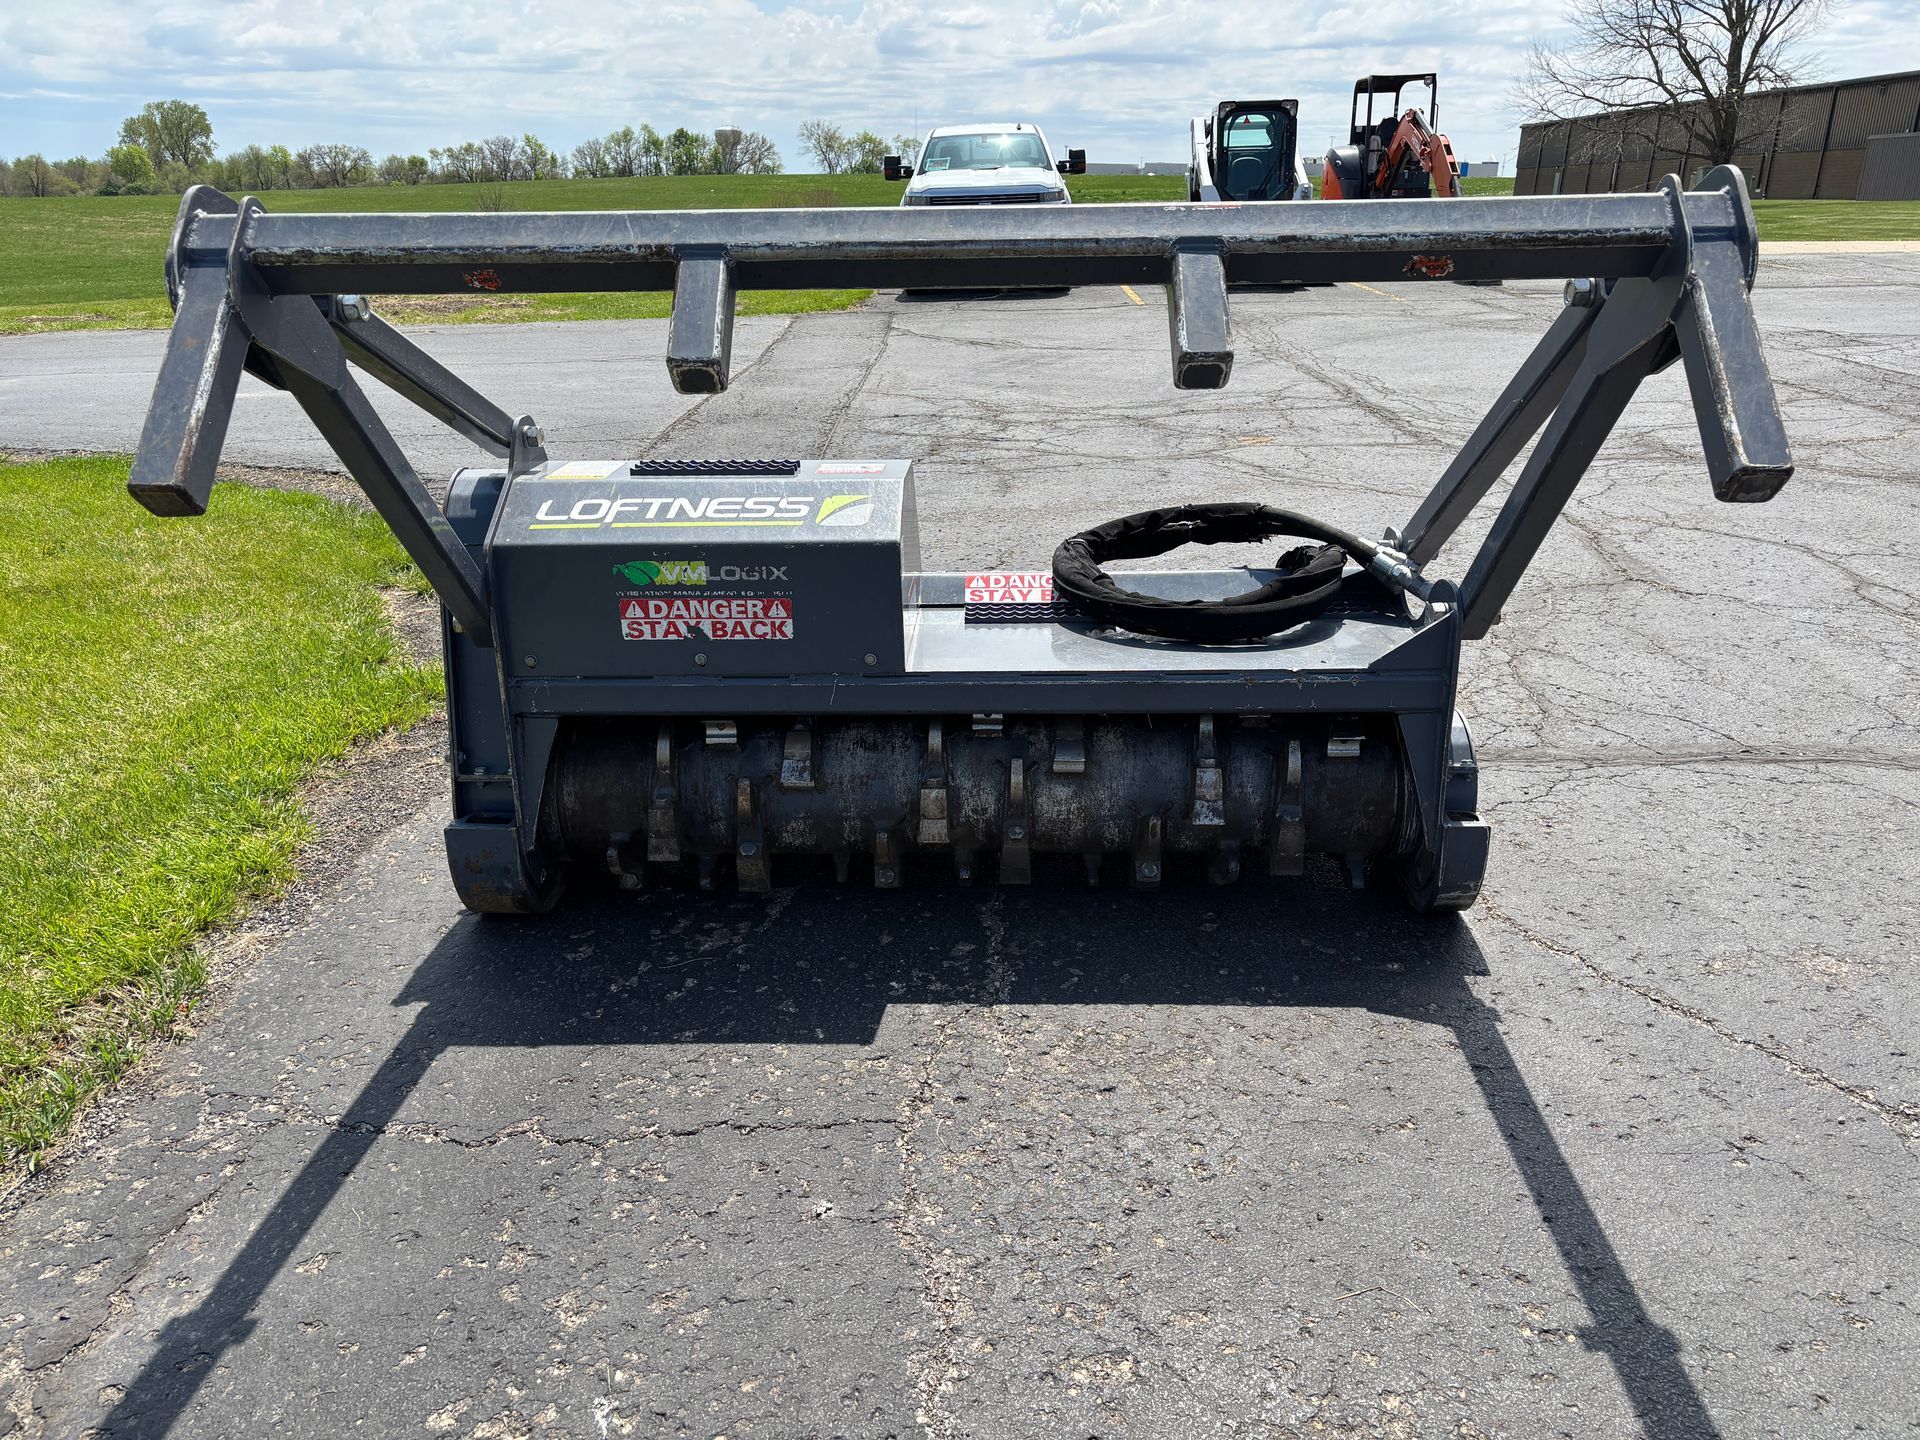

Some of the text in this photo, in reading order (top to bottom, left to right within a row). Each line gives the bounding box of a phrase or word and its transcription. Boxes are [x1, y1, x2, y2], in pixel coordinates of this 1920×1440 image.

[535, 496, 815, 523] LOFTNESS
[660, 565, 789, 582] VMLOGIX
[990, 575, 1053, 588] DANG
[970, 589, 1033, 602] STAY
[648, 599, 764, 618] DANGER
[712, 620, 788, 639] BACK
